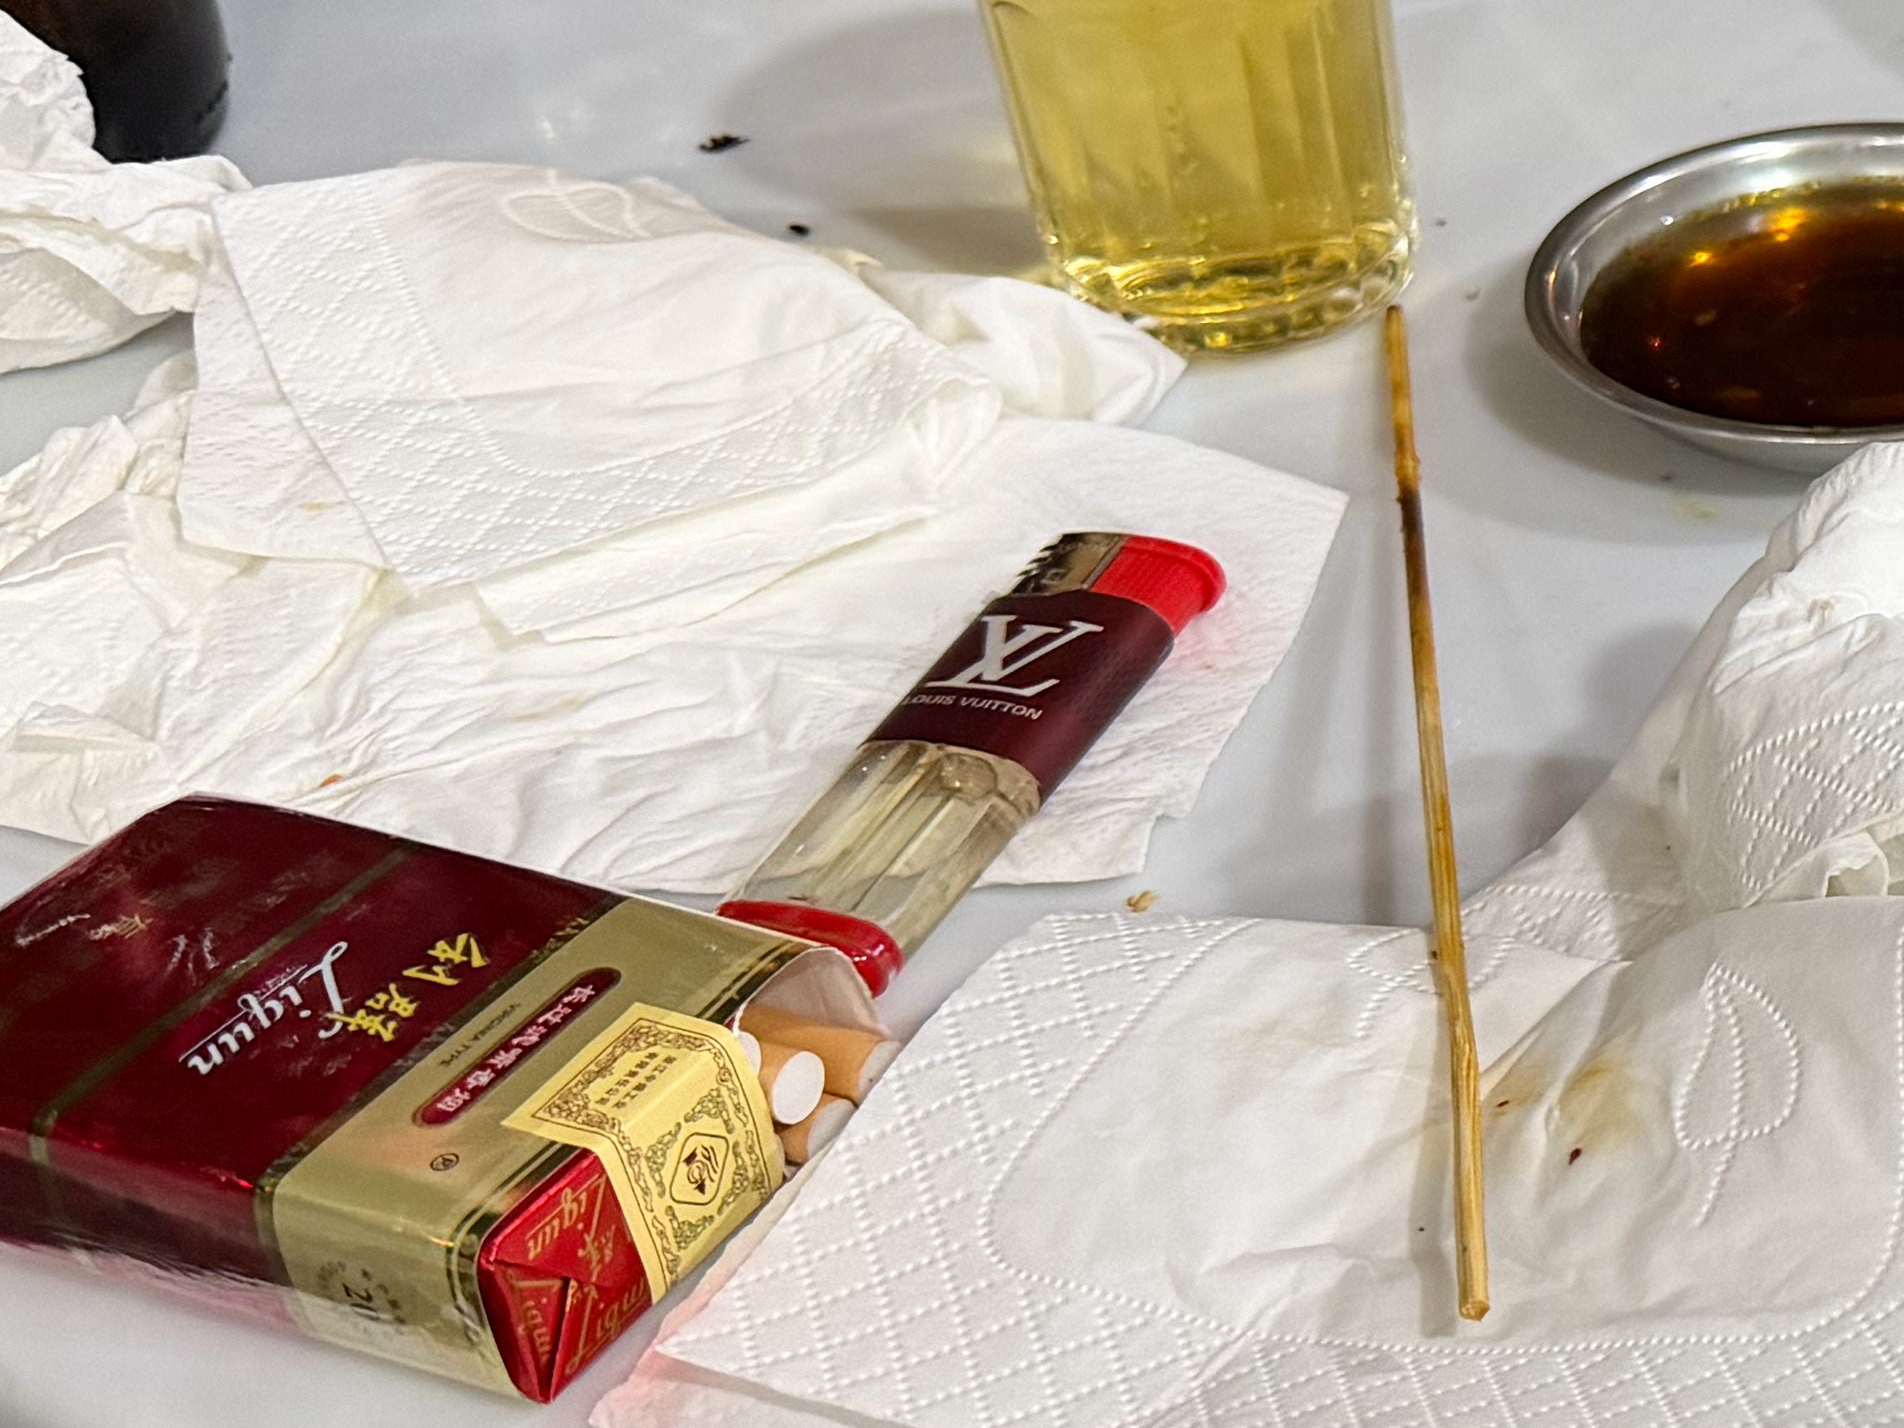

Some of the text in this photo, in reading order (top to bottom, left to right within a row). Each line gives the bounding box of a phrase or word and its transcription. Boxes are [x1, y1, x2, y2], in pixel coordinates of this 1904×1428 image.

[901, 693, 1044, 721] LOUIS VUITTON
[178, 940, 349, 1075] Liqun
[323, 932, 490, 1042] 利群
[437, 984, 597, 1113] 长过滤嘴香烟
